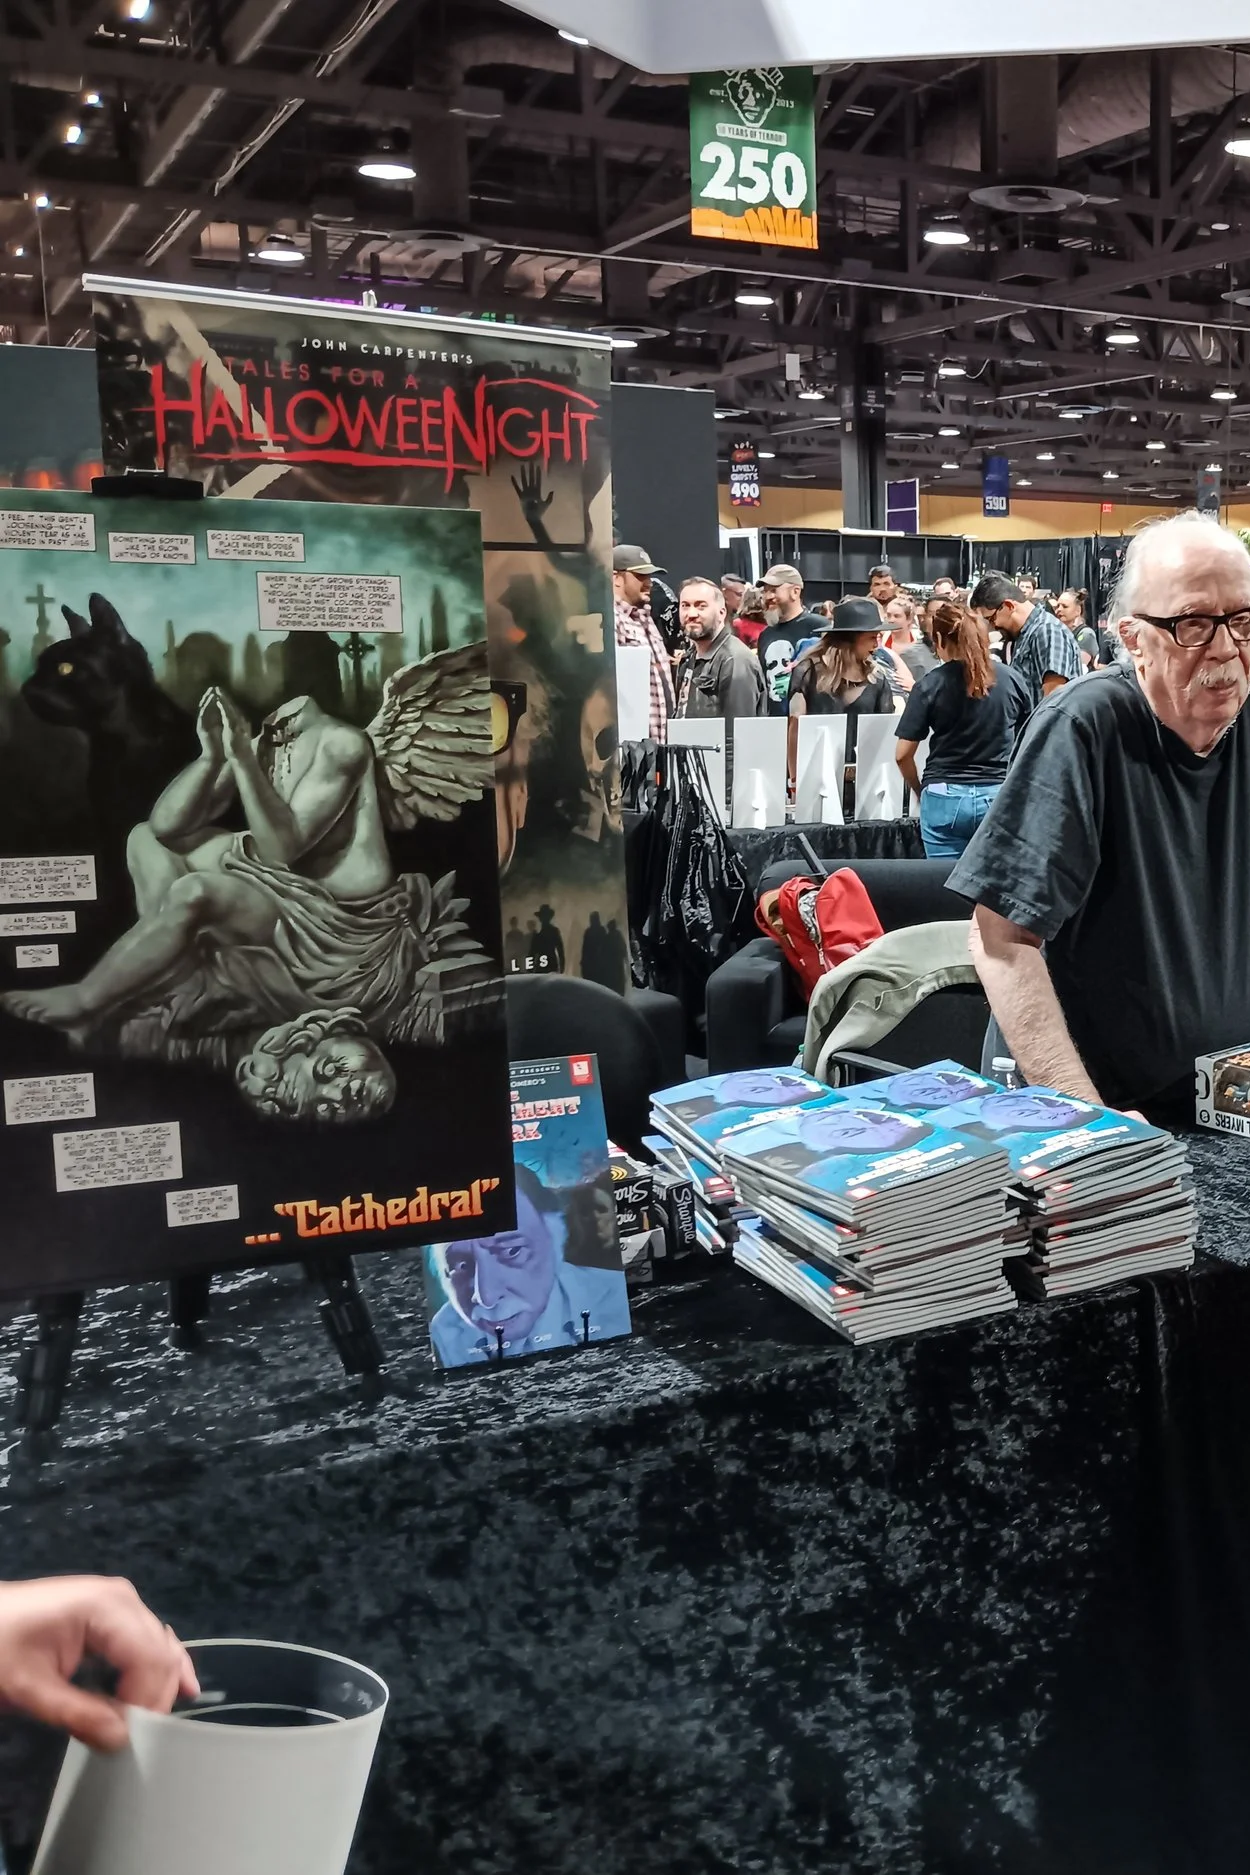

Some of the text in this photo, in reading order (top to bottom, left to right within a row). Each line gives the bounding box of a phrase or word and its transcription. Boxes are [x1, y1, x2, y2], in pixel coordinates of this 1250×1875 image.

[728, 126, 748, 137] YEARS
[749, 129, 757, 138] OF
[700, 141, 807, 208] 250
[301, 337, 474, 364] JOHN CARPENTER'S
[224, 357, 418, 389] TALES FOR A
[731, 482, 760, 498] 490
[985, 496, 1007, 510] 590
[510, 1078, 546, 1088] OMERO'S
[1215, 1112, 1245, 1133] MYERS
[672, 1187, 696, 1245] Sharpie
